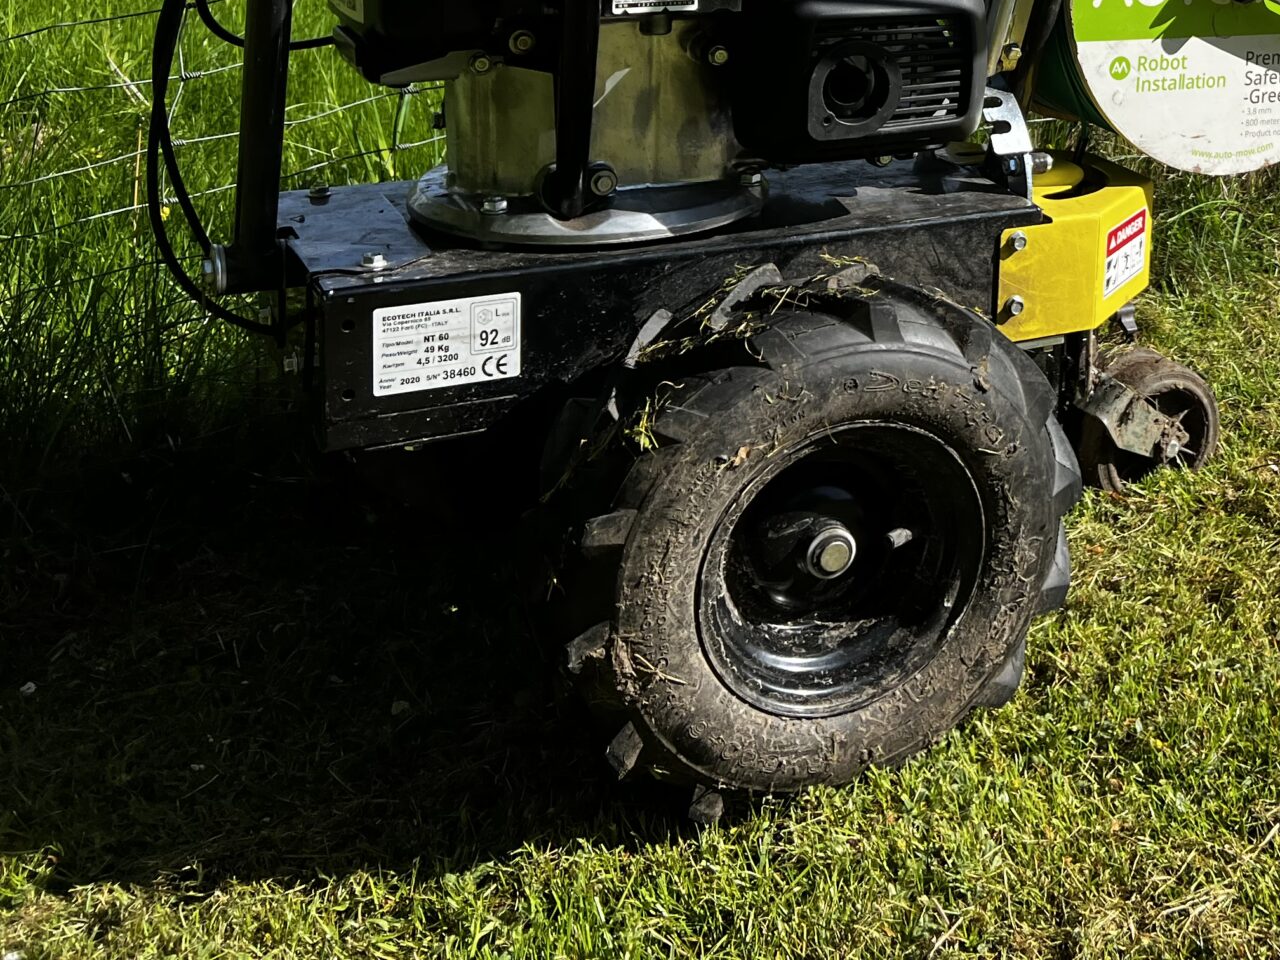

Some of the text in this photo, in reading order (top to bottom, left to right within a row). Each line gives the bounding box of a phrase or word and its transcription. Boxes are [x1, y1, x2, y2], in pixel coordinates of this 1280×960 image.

[1137, 54, 1188, 72] Robot
[1135, 73, 1227, 93] Installation
[1244, 129, 1271, 138] Product
[1191, 142, 1274, 159] www.auto-mow.com
[382, 307, 461, 322] ECOTECH ITALIA S.R.L.
[423, 335, 436, 343] NT
[438, 332, 449, 341] 60
[479, 328, 511, 347] 92 dB
[424, 345, 435, 353] 49
[437, 344, 449, 353] Kg
[437, 353, 459, 363] 3200
[481, 353, 508, 377] CE
[400, 376, 420, 385] 2020
[442, 366, 476, 380] 38460
